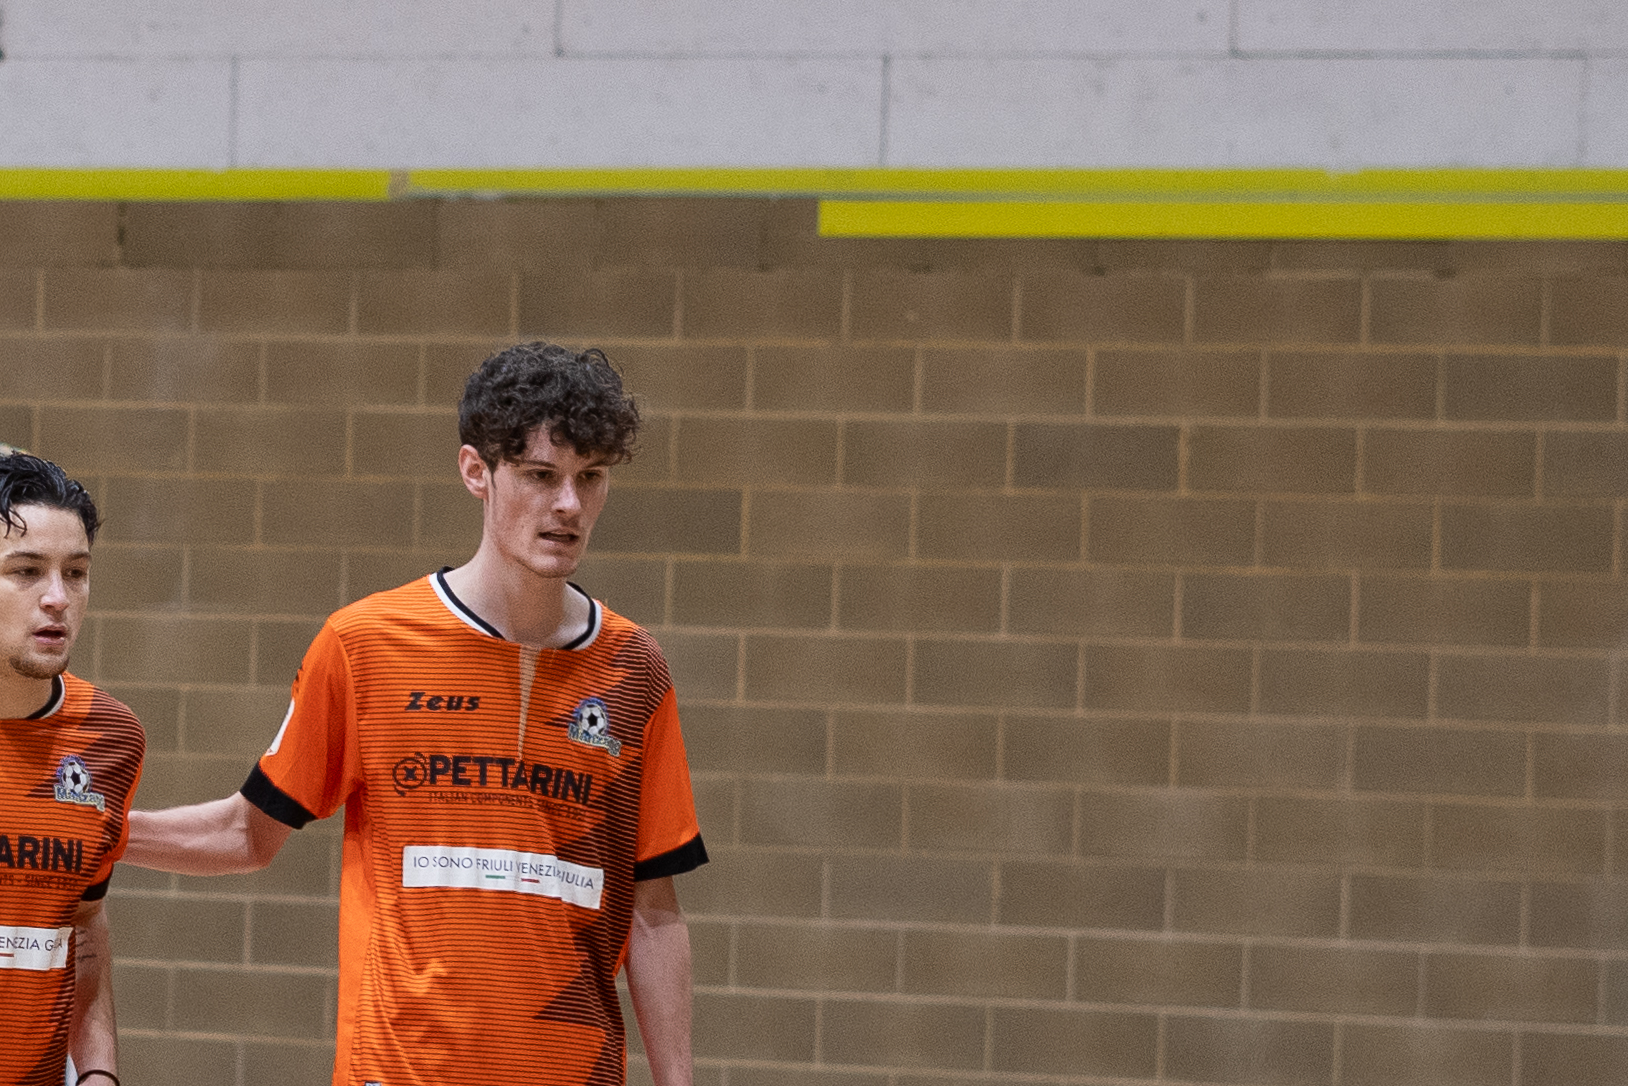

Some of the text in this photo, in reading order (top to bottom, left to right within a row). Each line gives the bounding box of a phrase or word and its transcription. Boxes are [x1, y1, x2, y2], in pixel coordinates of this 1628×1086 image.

[405, 691, 480, 711] Zeus
[429, 754, 593, 805] PETTARINI
[413, 856, 430, 868] IO
[433, 856, 473, 869] SONO
[476, 858, 513, 872] FRIULI
[560, 871, 594, 890] IULIA
